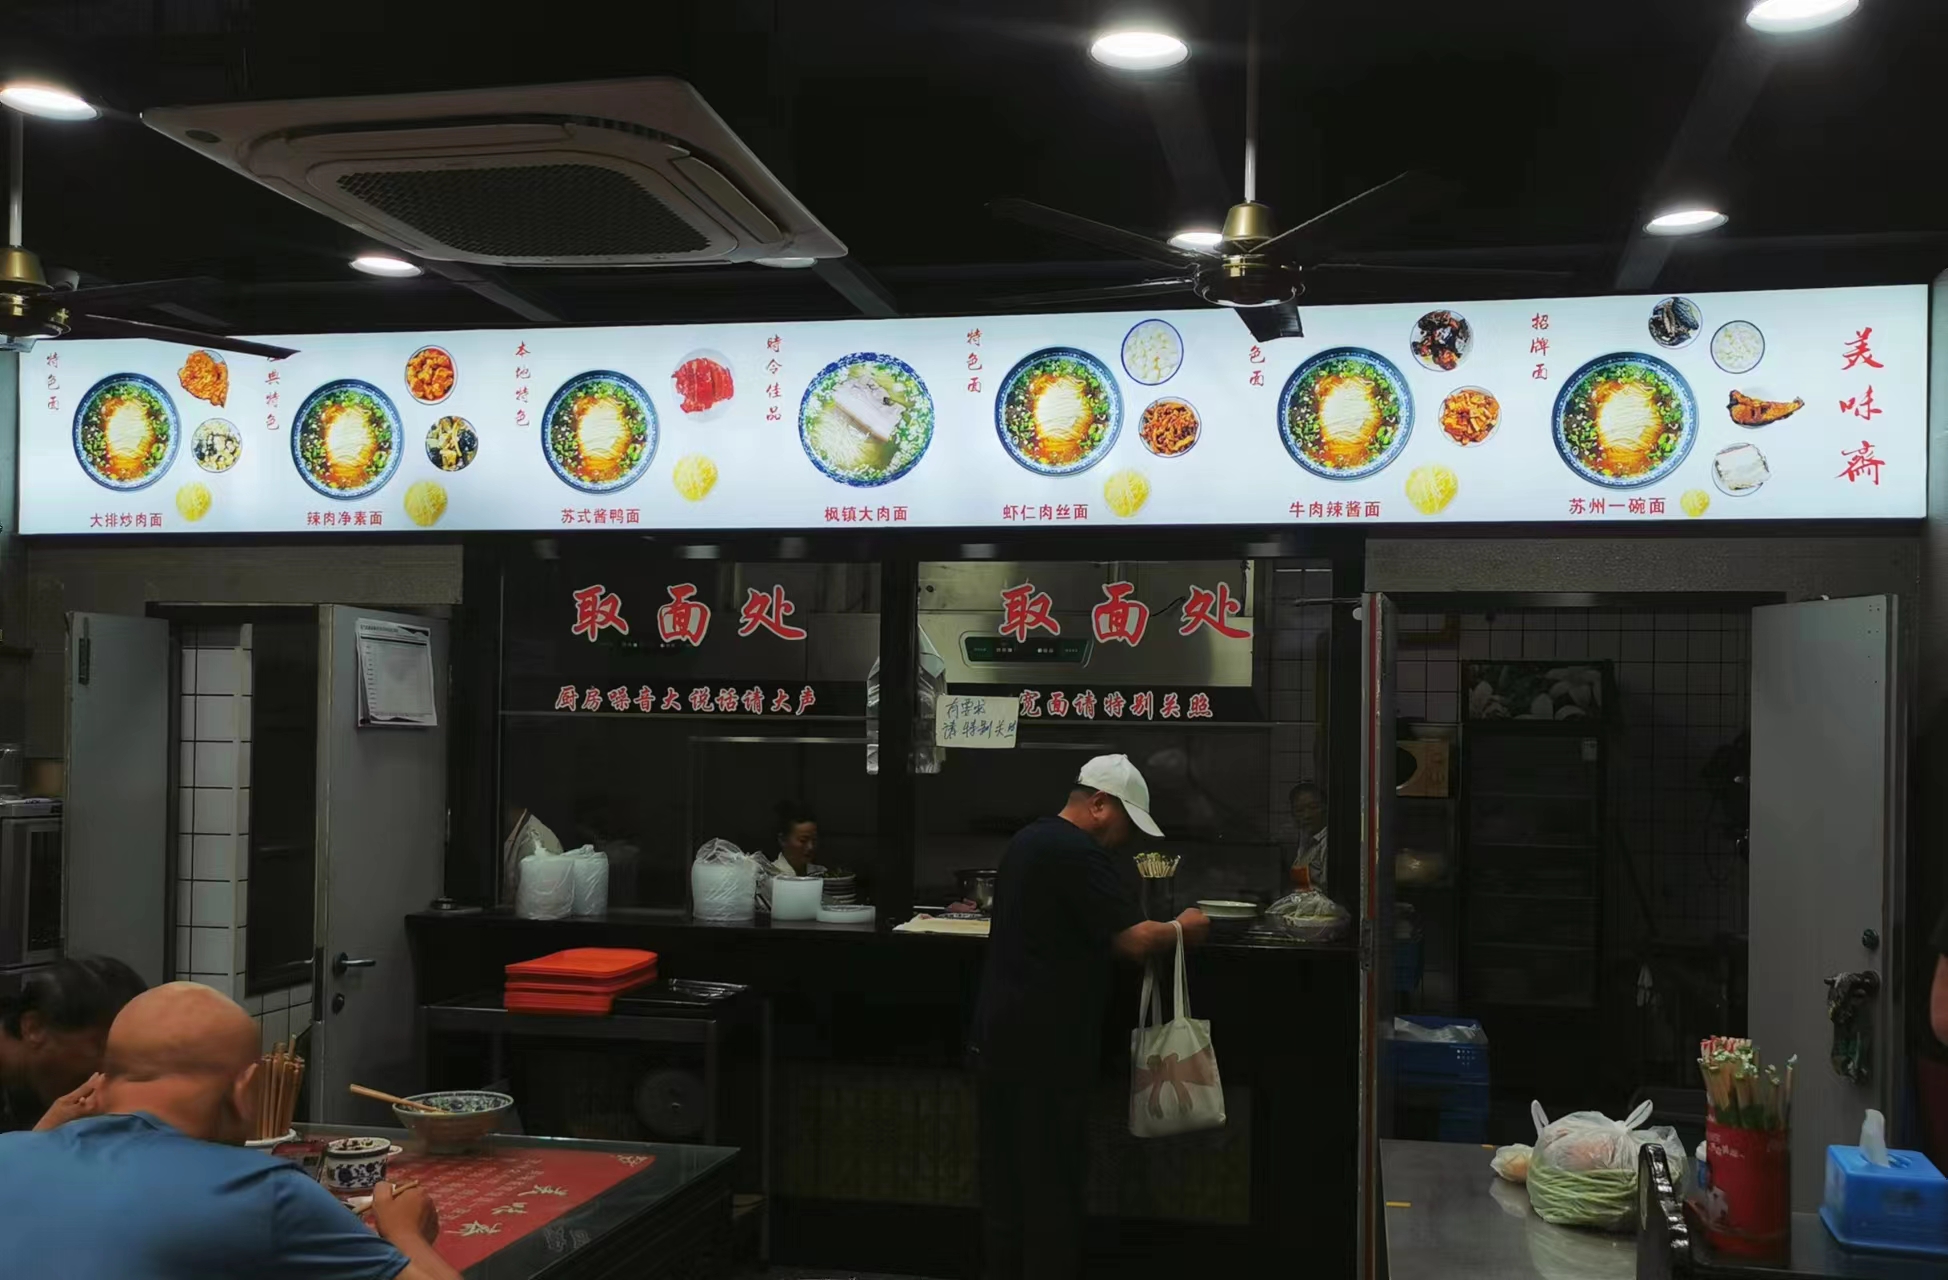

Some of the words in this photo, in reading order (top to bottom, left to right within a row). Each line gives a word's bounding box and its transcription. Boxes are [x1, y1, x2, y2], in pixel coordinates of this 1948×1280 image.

[966, 328, 983, 394] 特色面
[1248, 332, 1266, 387] 色面
[1529, 312, 1550, 381] 招牌面
[45, 352, 61, 411] 特色面
[264, 356, 281, 431] 典特色
[514, 340, 532, 427] 本地特色
[89, 512, 163, 529] 大排炒肉面
[306, 510, 383, 527] 辣肉净素面
[560, 508, 641, 525] 苏式酱鸭面
[823, 506, 908, 523] 枫镇大肉面
[1002, 504, 1089, 521] 虾仁肉丝面
[1288, 501, 1381, 518] 牛肉辣酱面
[1568, 497, 1667, 515] 苏州一碗面
[571, 583, 807, 646] 取面处
[1000, 581, 1253, 647] 取面处
[555, 685, 816, 715] 厨房噪音大说话请大声
[1018, 689, 1213, 719] 宽面请特别关照
